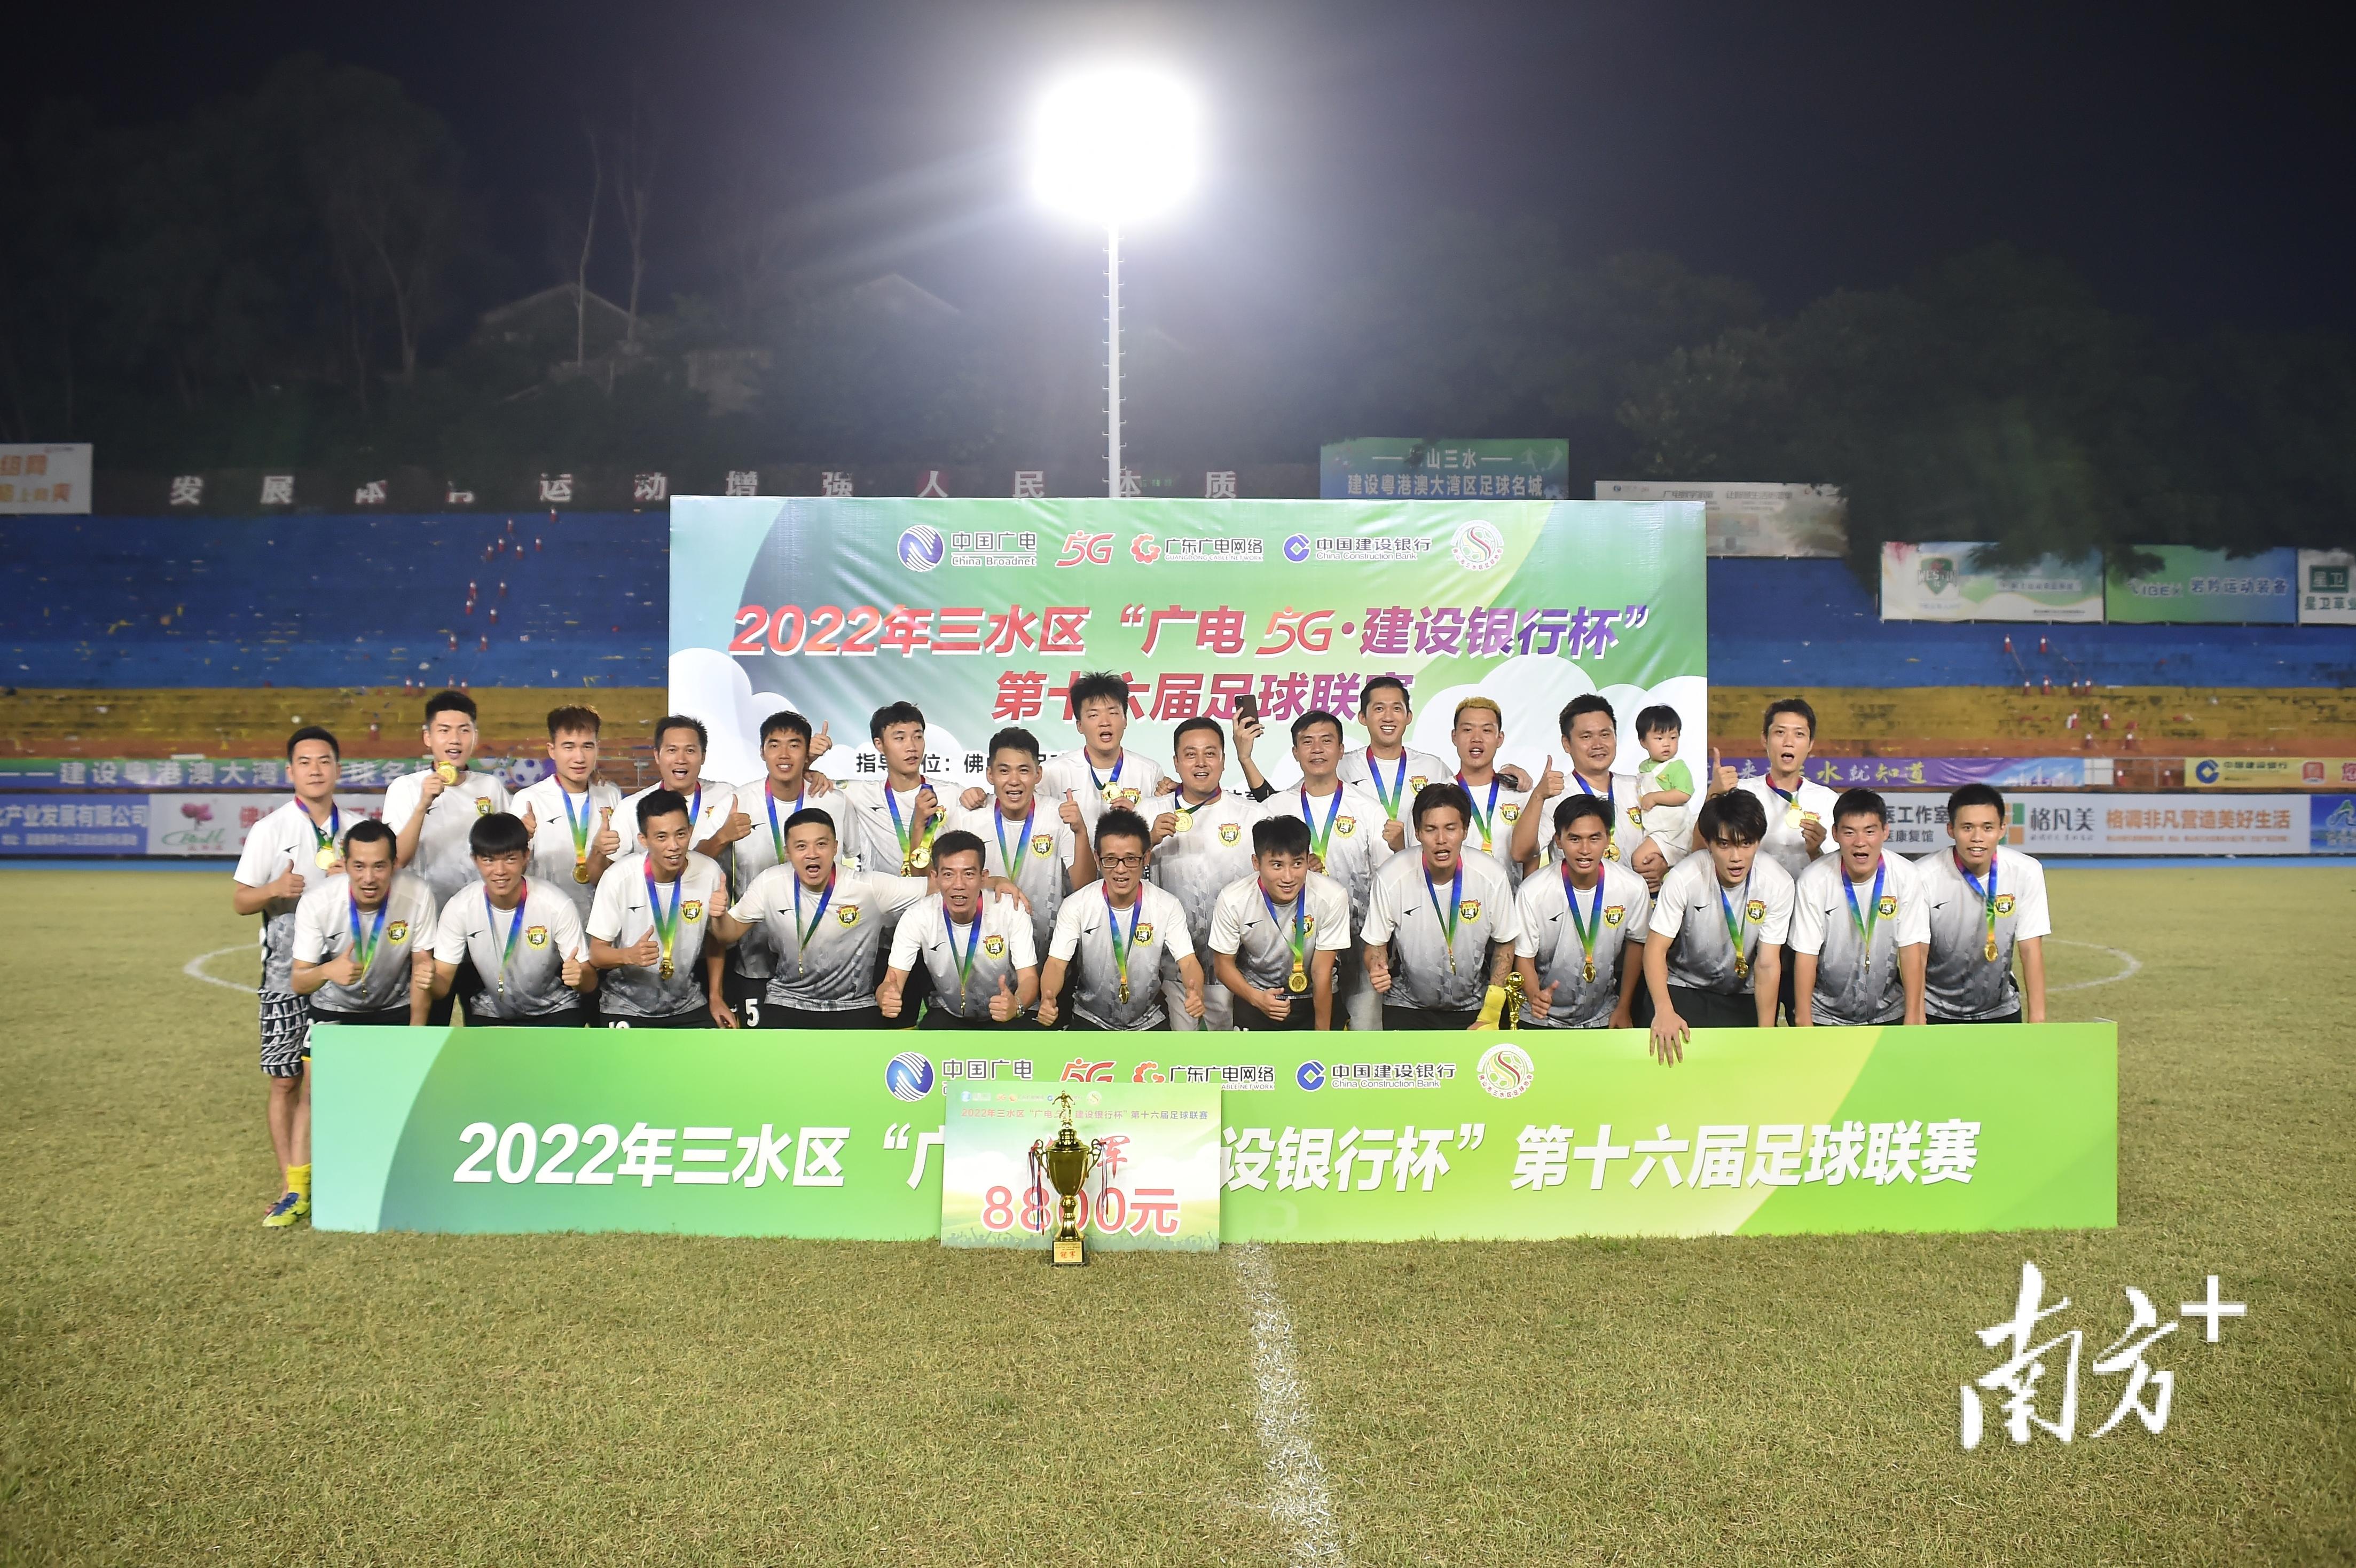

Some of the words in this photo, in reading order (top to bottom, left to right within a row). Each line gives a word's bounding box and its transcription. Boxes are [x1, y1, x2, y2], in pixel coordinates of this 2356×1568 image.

[1348, 474, 1542, 497] 建设粤港澳大湾区足球名城
[952, 532, 1035, 550] 中国广电
[1055, 530, 1114, 566] 5G
[1166, 538, 1262, 553] 广东广电网络
[1316, 538, 1431, 551] 中国建设银行
[952, 557, 981, 565] China
[986, 557, 1035, 565] Broadnet
[2031, 808, 2095, 831] 格凡美
[745, 998, 759, 1027] 5
[943, 1059, 1032, 1079] 中国广电
[1170, 1066, 1274, 1082] 广东广电网络
[1332, 1064, 1456, 1078] 中国建设银行
[1332, 1080, 1358, 1088] China
[1361, 1080, 1415, 1088] Construction
[1417, 1080, 1440, 1088] Bank
